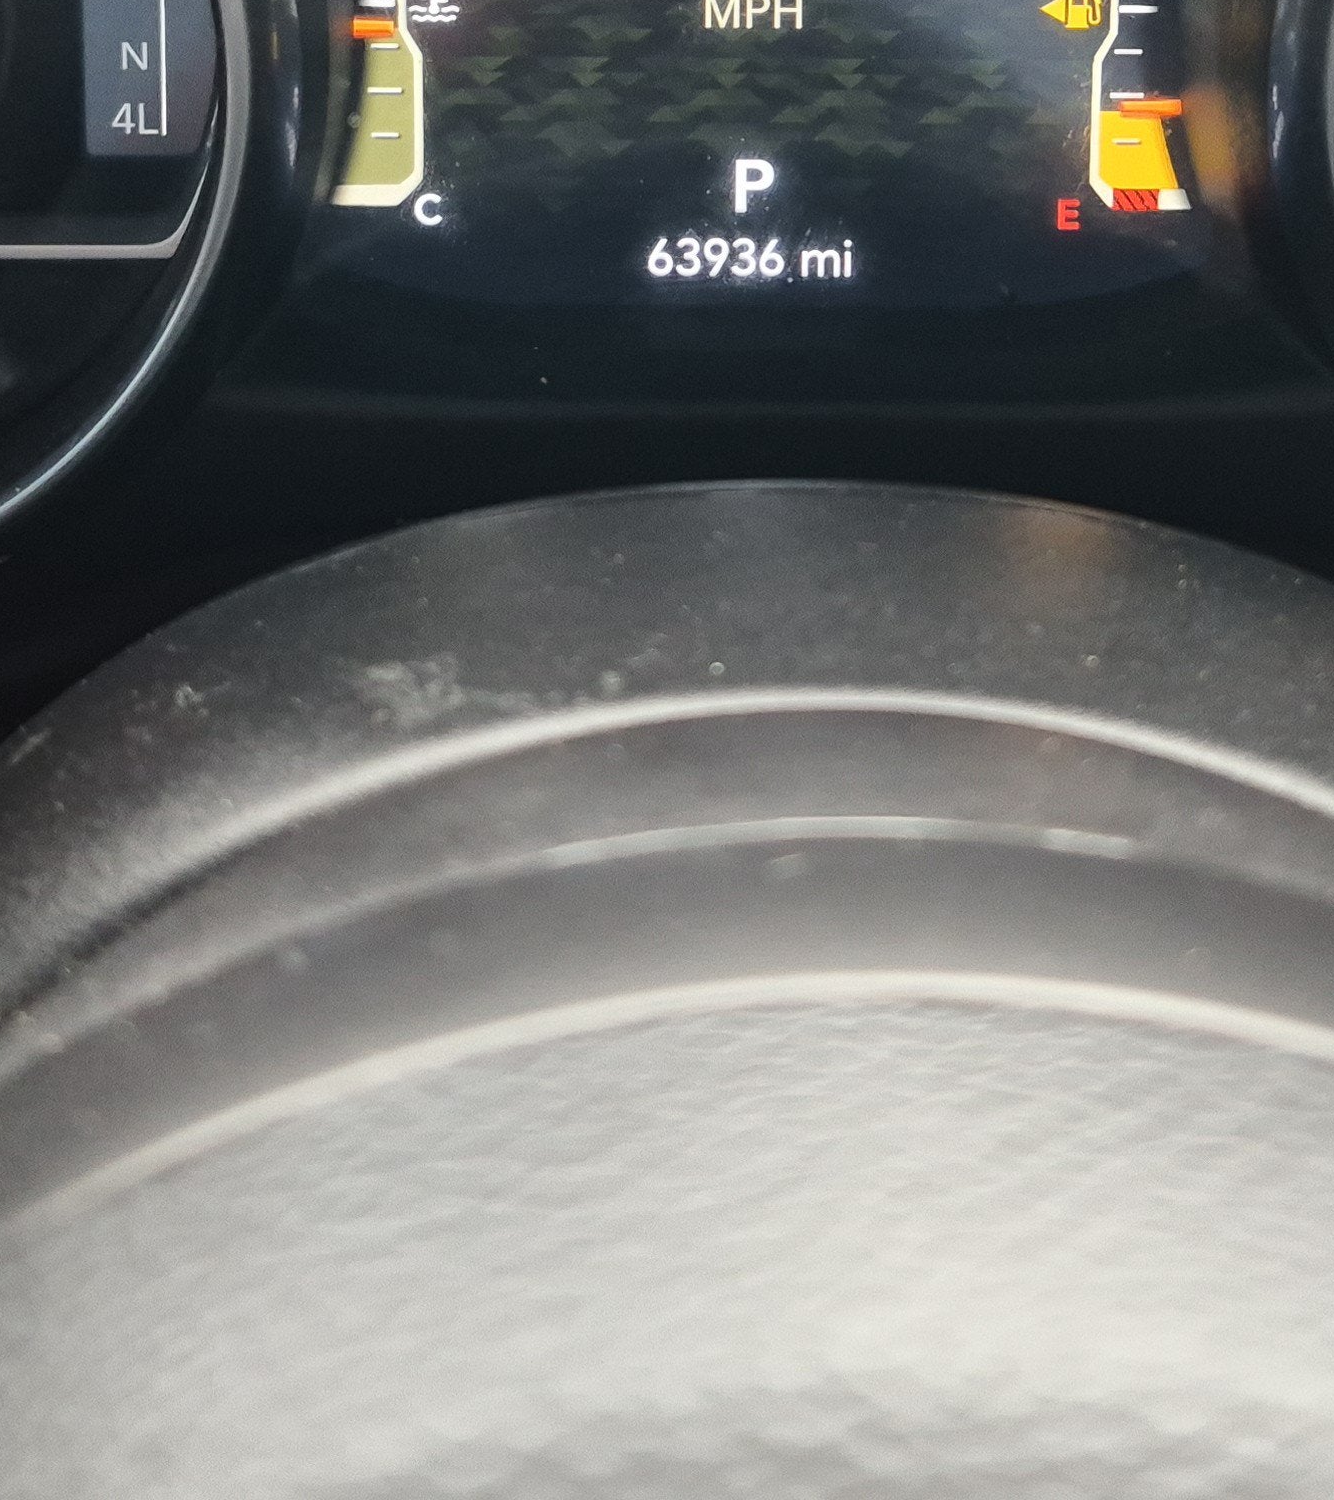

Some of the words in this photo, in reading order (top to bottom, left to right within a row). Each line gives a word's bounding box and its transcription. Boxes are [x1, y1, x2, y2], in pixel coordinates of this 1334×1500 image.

[120, 40, 149, 72] N
[110, 101, 160, 136] 4L
[733, 159, 775, 213] P
[413, 194, 443, 227] C
[1054, 196, 1082, 232] E
[645, 234, 787, 282] 63936
[799, 237, 854, 280] mi
